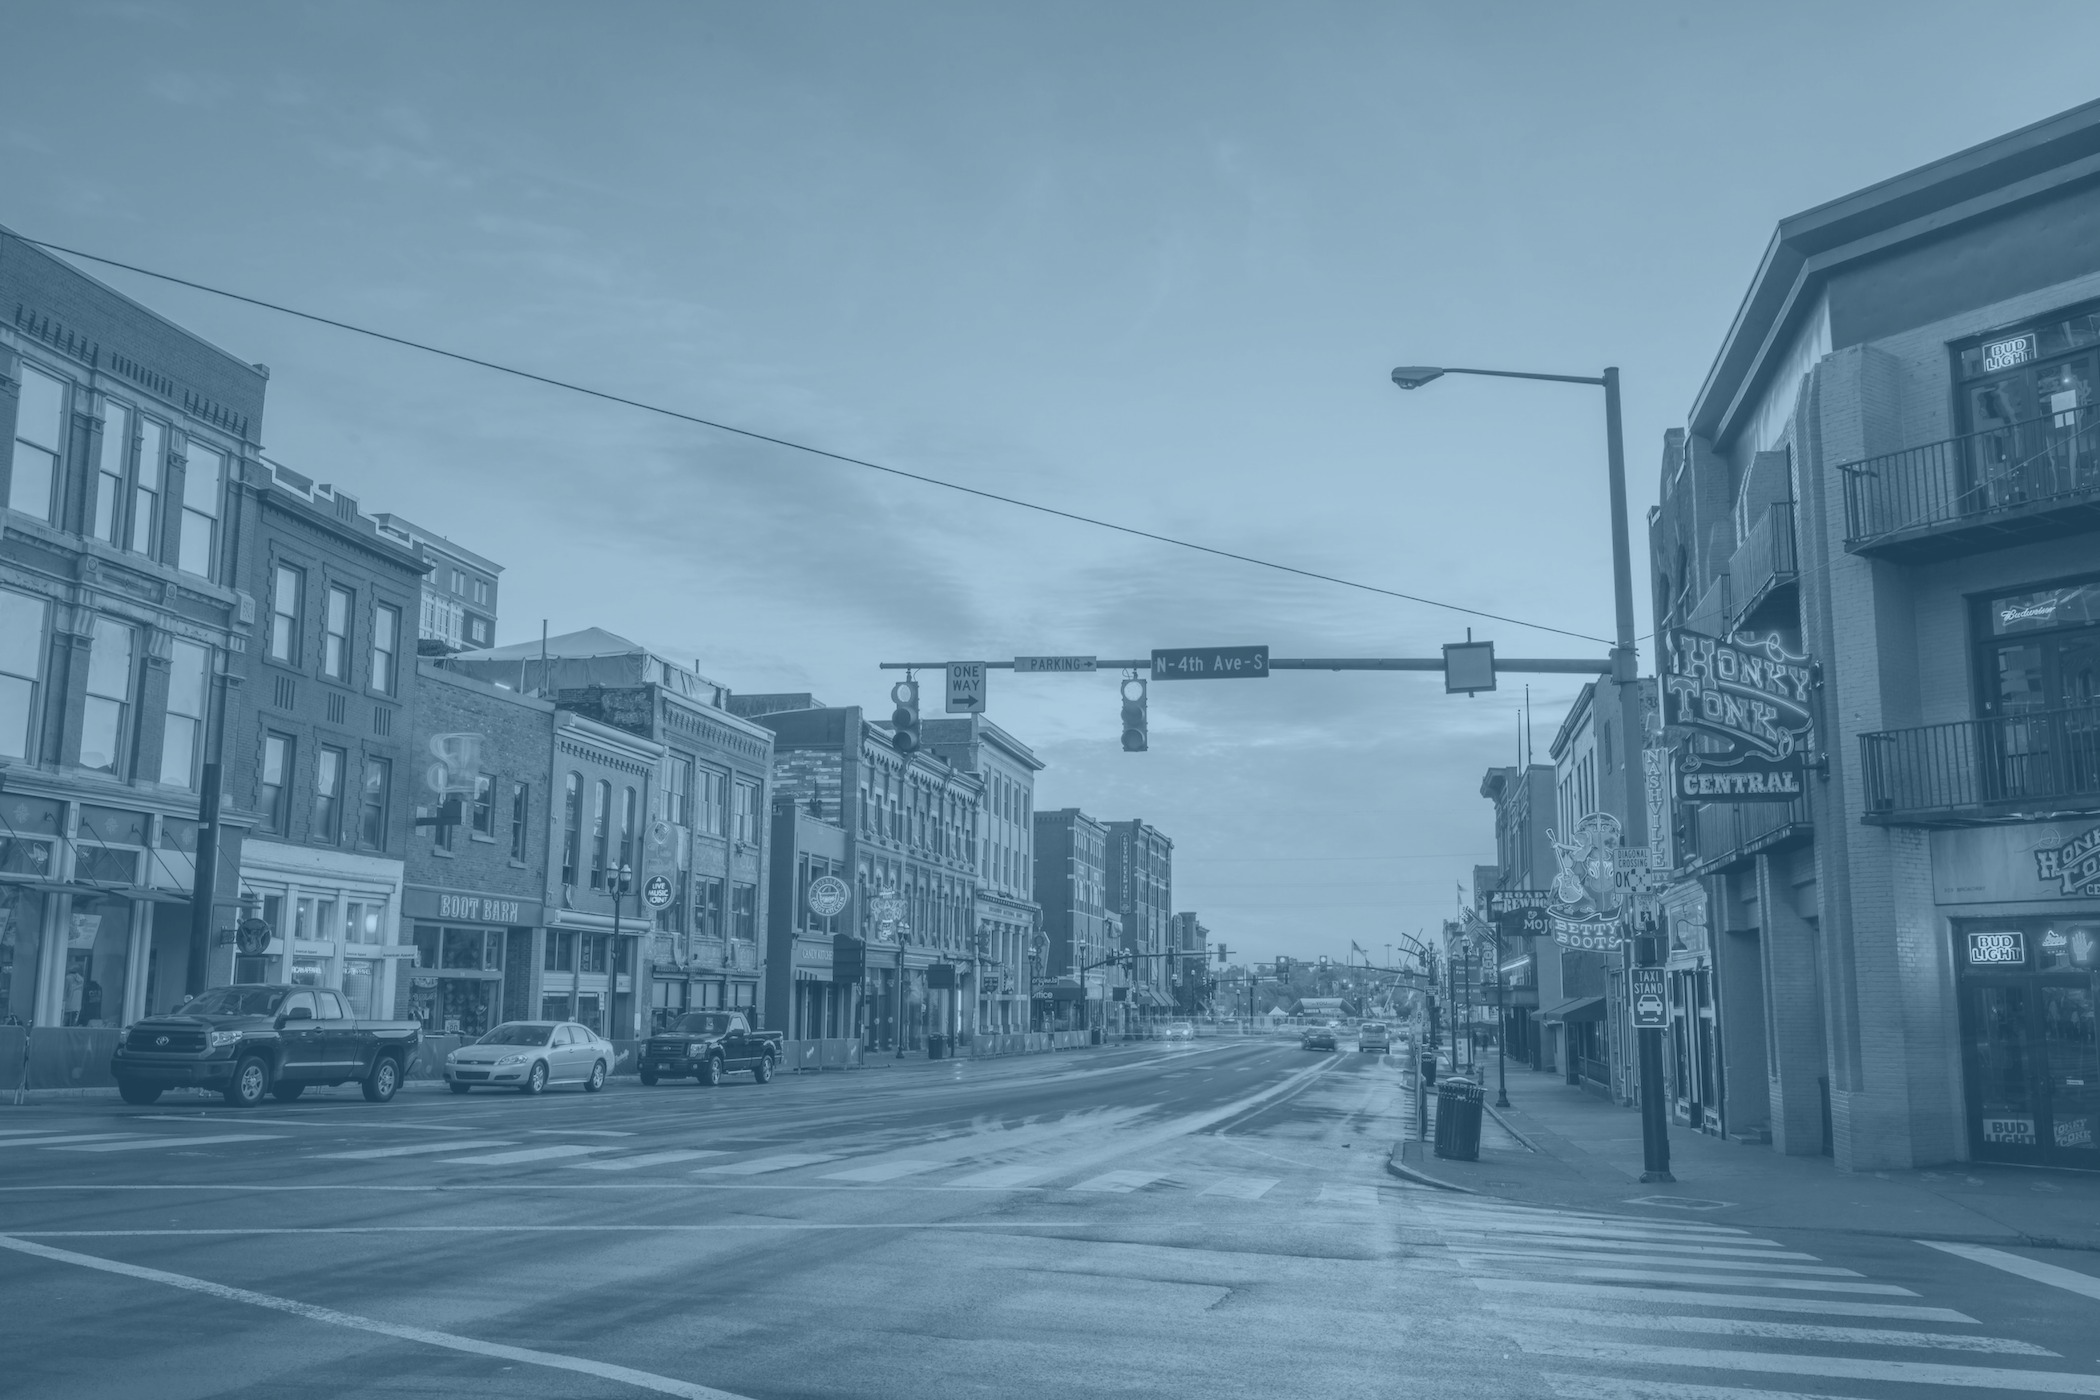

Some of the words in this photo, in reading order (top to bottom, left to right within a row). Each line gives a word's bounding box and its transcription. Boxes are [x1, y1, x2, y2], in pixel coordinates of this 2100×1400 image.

[1991, 339, 2027, 358] BUD
[1985, 350, 2033, 371] LIGHT
[953, 665, 979, 677] ONE
[1030, 658, 1081, 670] PARKING
[1679, 634, 1811, 703] HONKY
[952, 679, 980, 691] WAY
[1666, 673, 1779, 744] TONK
[1683, 771, 1800, 796] CENTRAL
[1646, 750, 1665, 867] NASHVILLE
[1618, 850, 1648, 859] DIAGONAL
[1618, 859, 1648, 868] CROSSING
[1615, 871, 1630, 888] OK
[1652, 872, 1669, 881] ITY
[439, 894, 479, 920] BOOT
[482, 899, 519, 923] BARN
[1555, 918, 1621, 937] BETTY
[1556, 931, 1620, 950] BOOTS
[1977, 934, 2014, 948] BUD
[817, 950, 834, 961] KITCHE
[1972, 947, 2021, 962] LIGHT
[1639, 971, 1659, 982] TAXI
[1633, 982, 1664, 994] STAND
[1992, 1121, 2029, 1134] BUD
